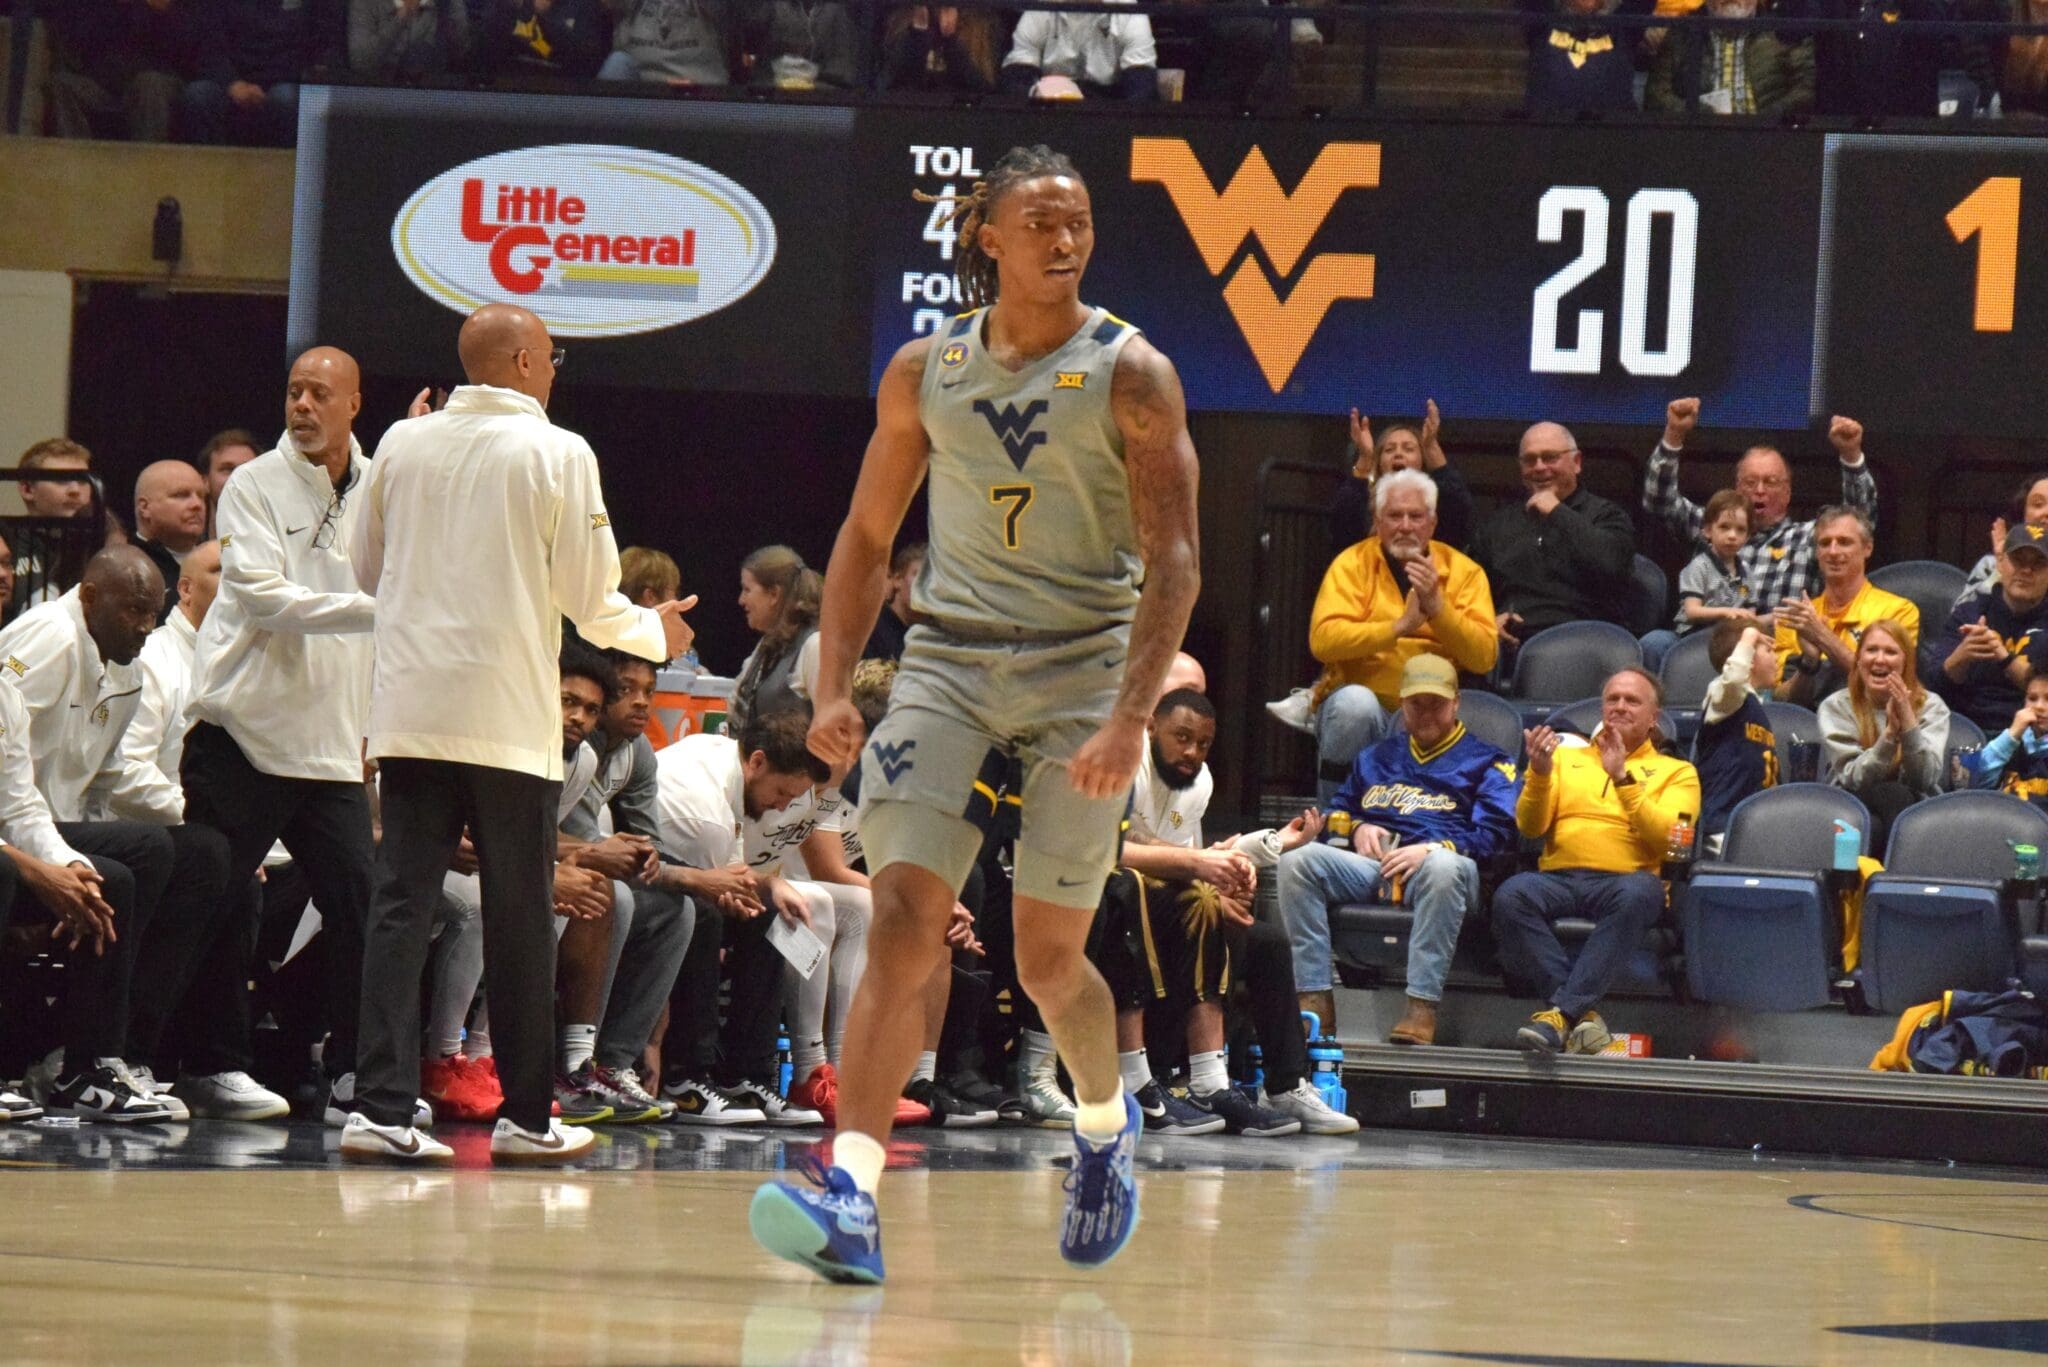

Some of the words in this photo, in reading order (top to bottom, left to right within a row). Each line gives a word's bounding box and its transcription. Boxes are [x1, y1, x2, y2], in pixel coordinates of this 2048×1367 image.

[909, 145, 983, 177] TOL
[460, 177, 586, 243] Little
[923, 183, 957, 260] 4
[488, 225, 696, 295] General
[1530, 185, 1698, 377] 20
[1945, 177, 2021, 331] 1
[943, 348, 964, 363] 44
[990, 482, 1034, 549] 7
[1361, 785, 1395, 808] West
[1396, 784, 1457, 815] Virginia
